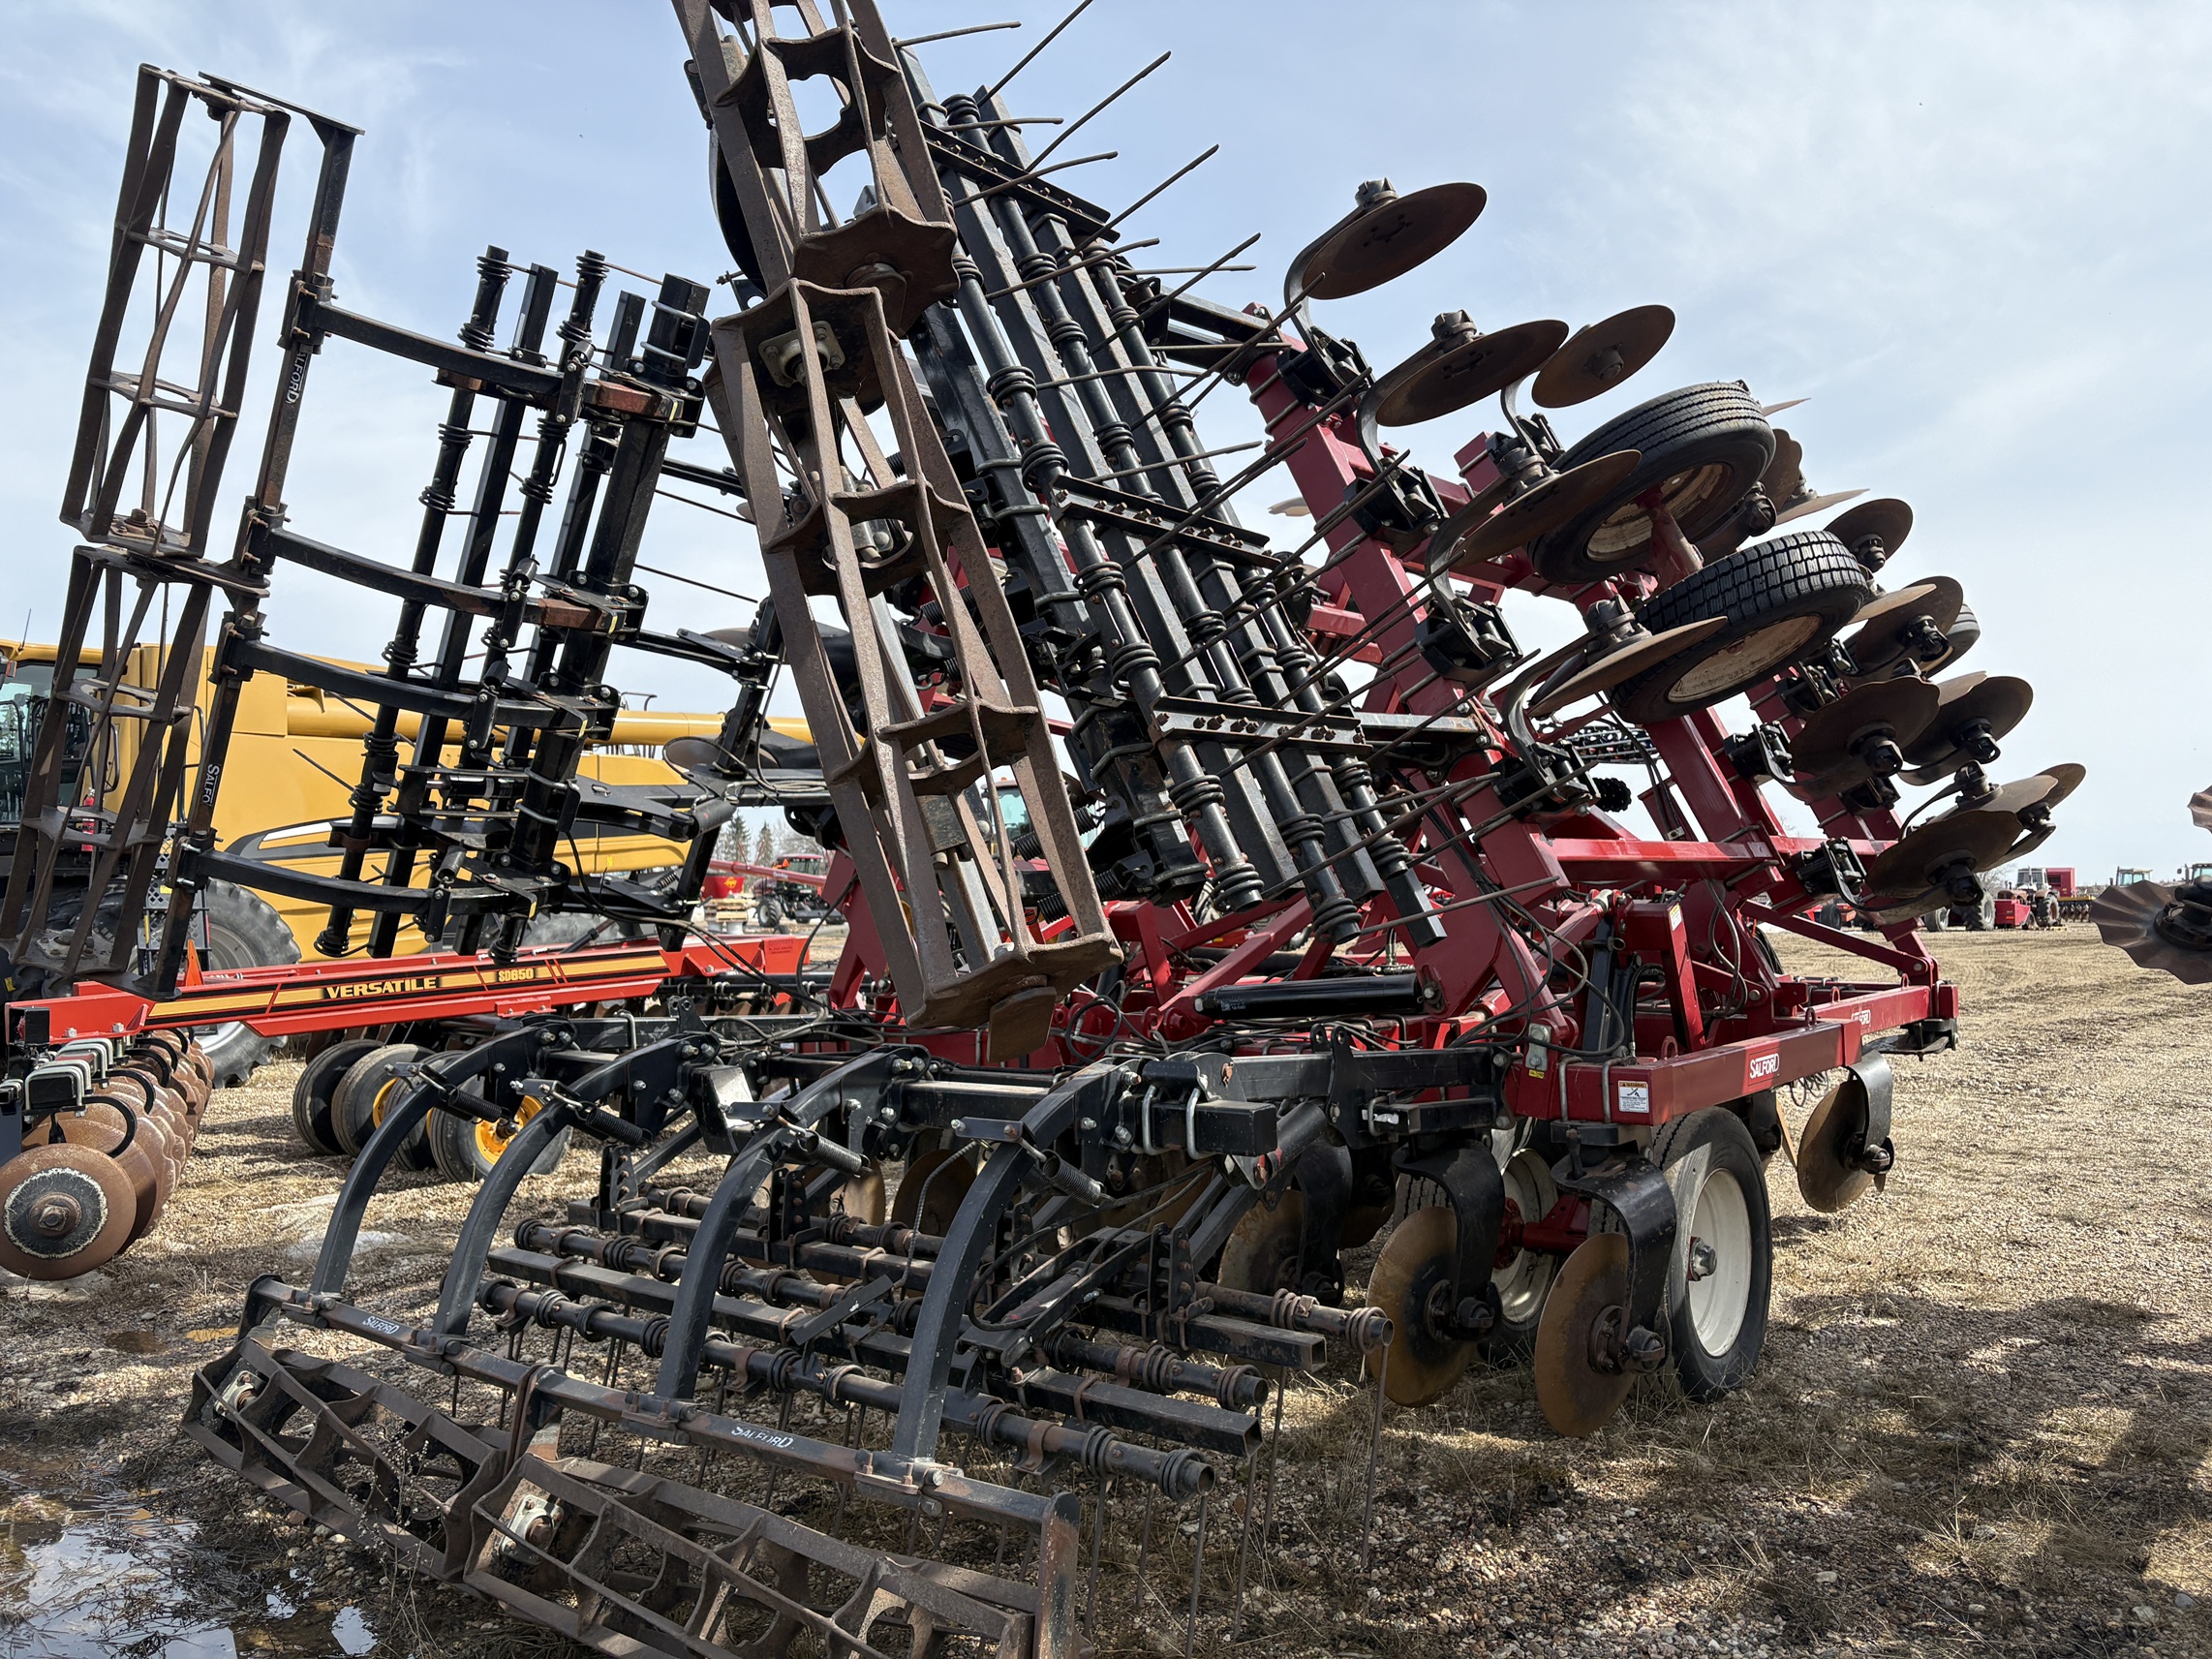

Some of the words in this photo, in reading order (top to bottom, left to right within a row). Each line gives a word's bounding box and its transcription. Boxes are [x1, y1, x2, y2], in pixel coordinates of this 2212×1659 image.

[286, 352, 307, 404] ALFORD
[326, 976, 437, 999] VERSATILE
[498, 968, 535, 983] SD650
[1749, 1053, 1780, 1079] SALFORD
[362, 1315, 400, 1335] SALFORD
[731, 1426, 794, 1449] SALFORD
